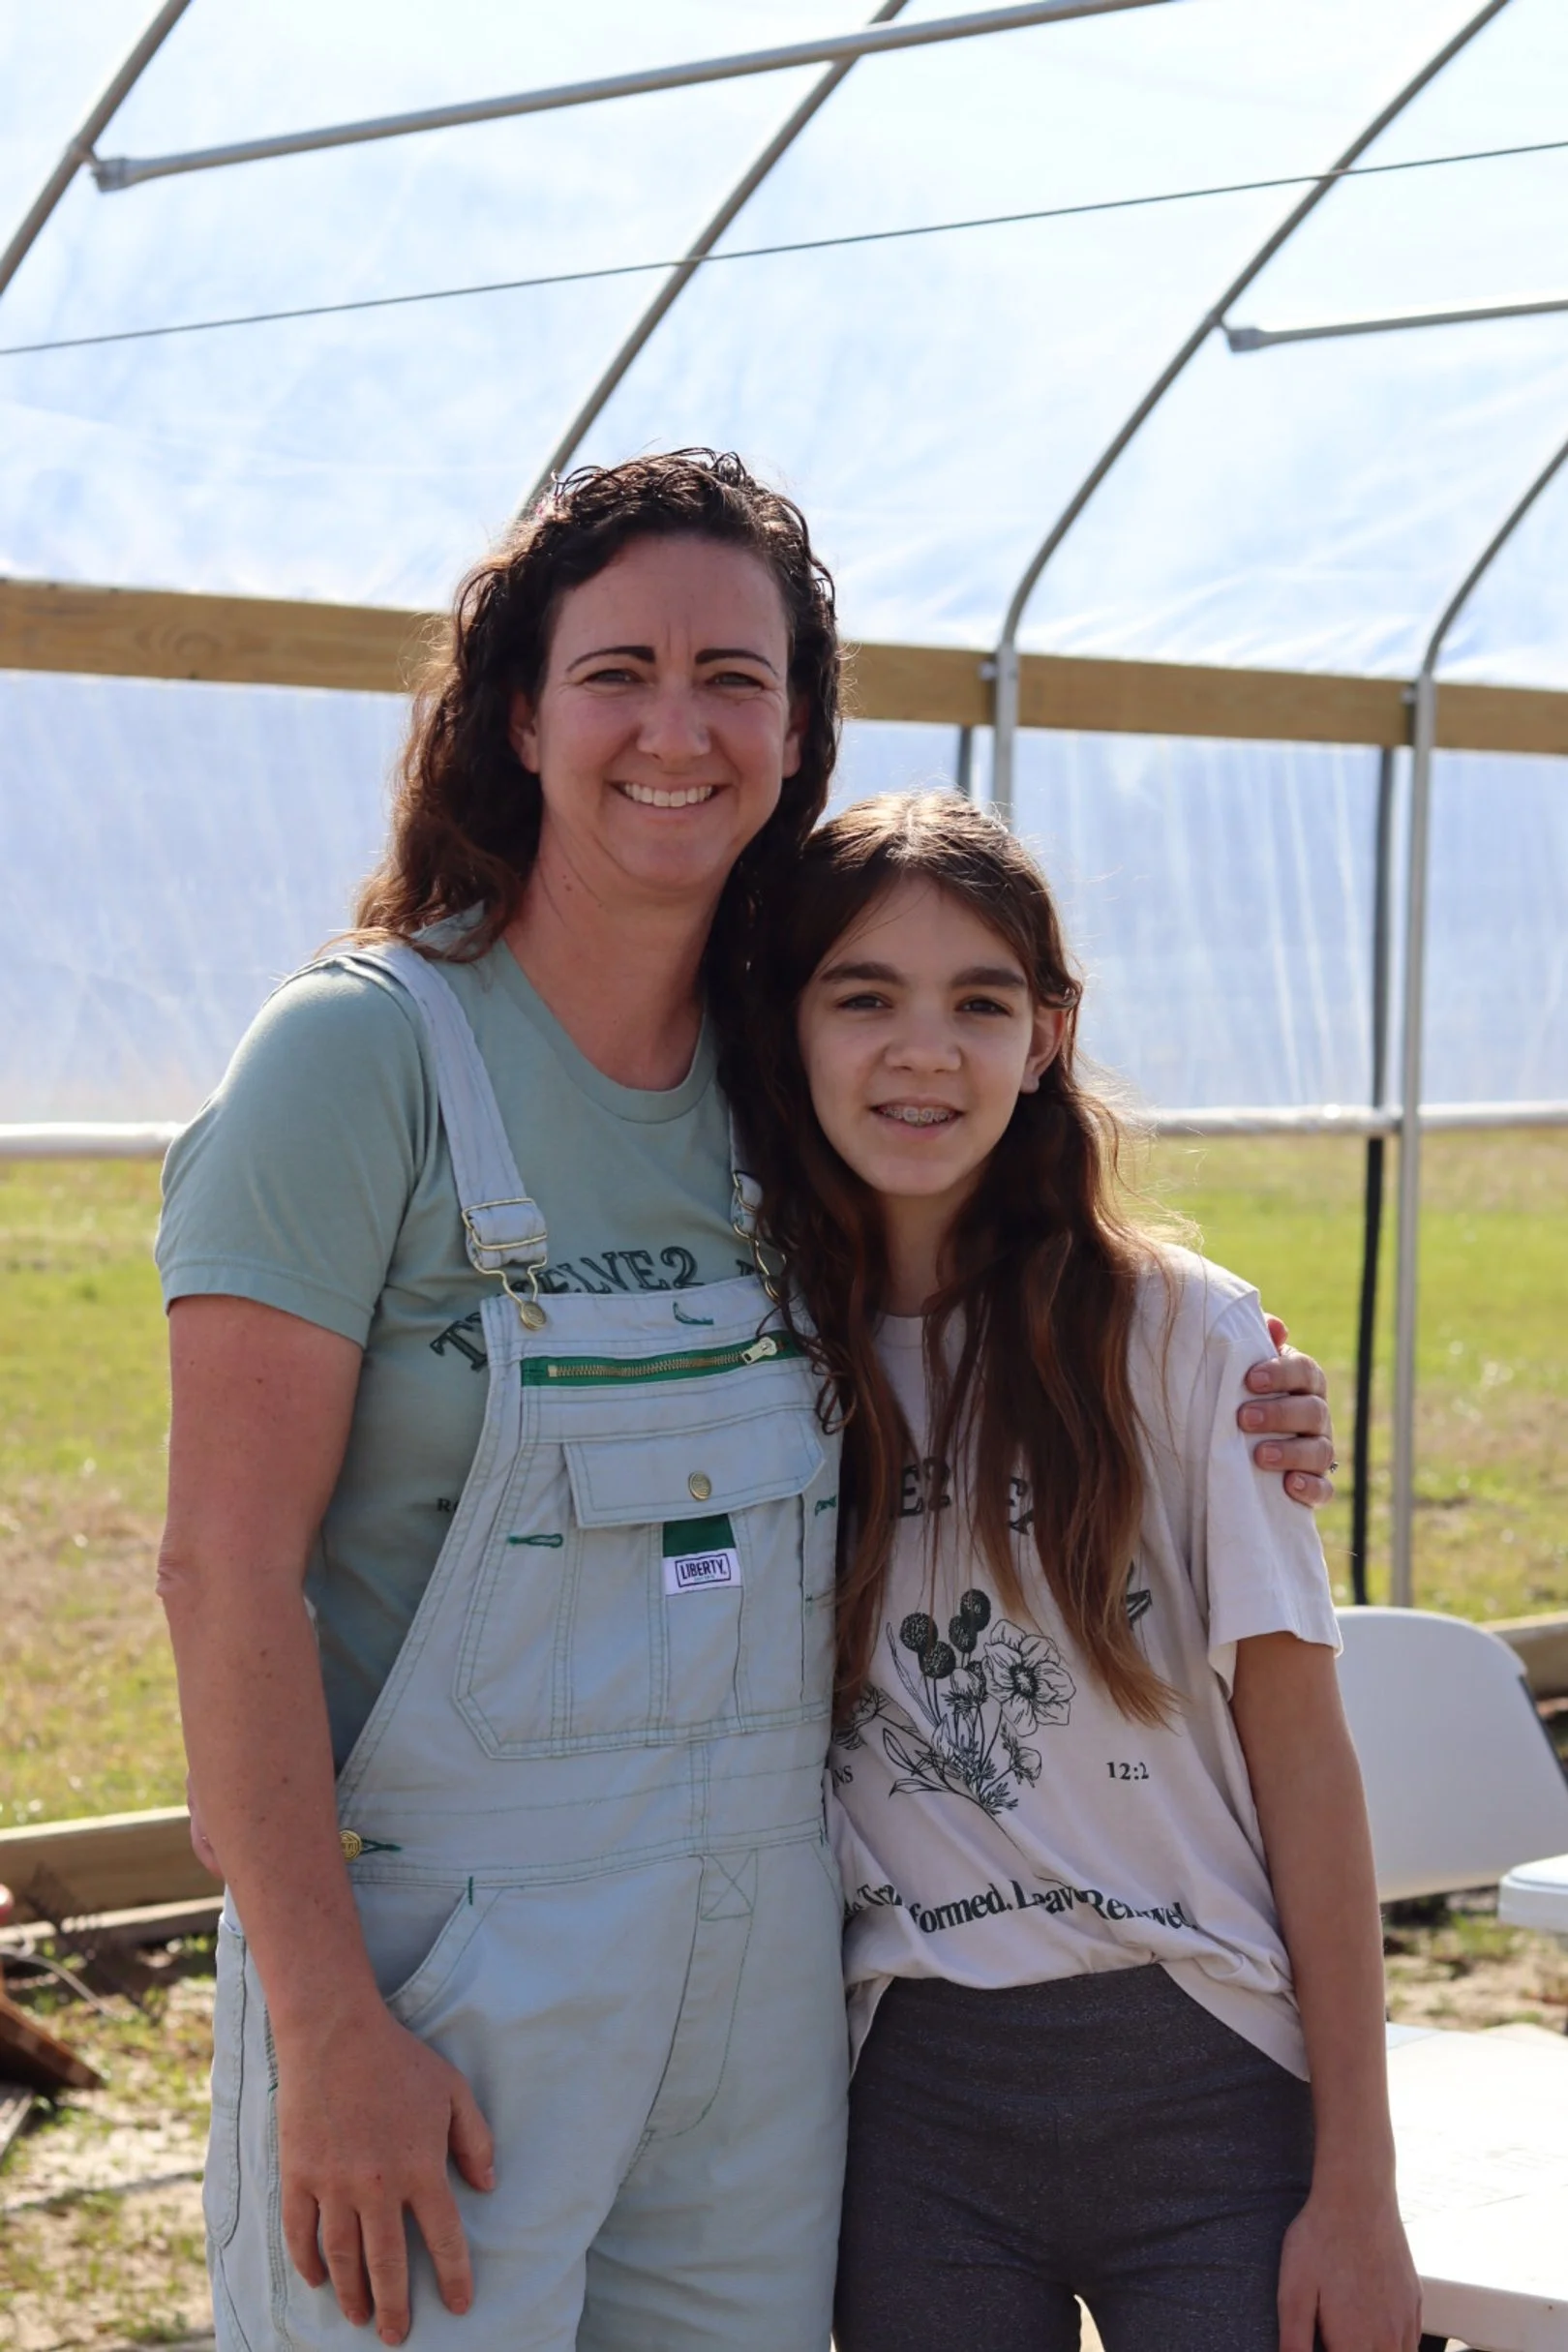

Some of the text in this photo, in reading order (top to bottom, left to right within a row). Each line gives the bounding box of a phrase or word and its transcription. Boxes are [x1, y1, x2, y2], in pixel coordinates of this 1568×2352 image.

[430, 1246, 705, 1372] TELVE2
[679, 1559, 724, 1580] LIBERTY
[1106, 1761, 1150, 1780] 12:2
